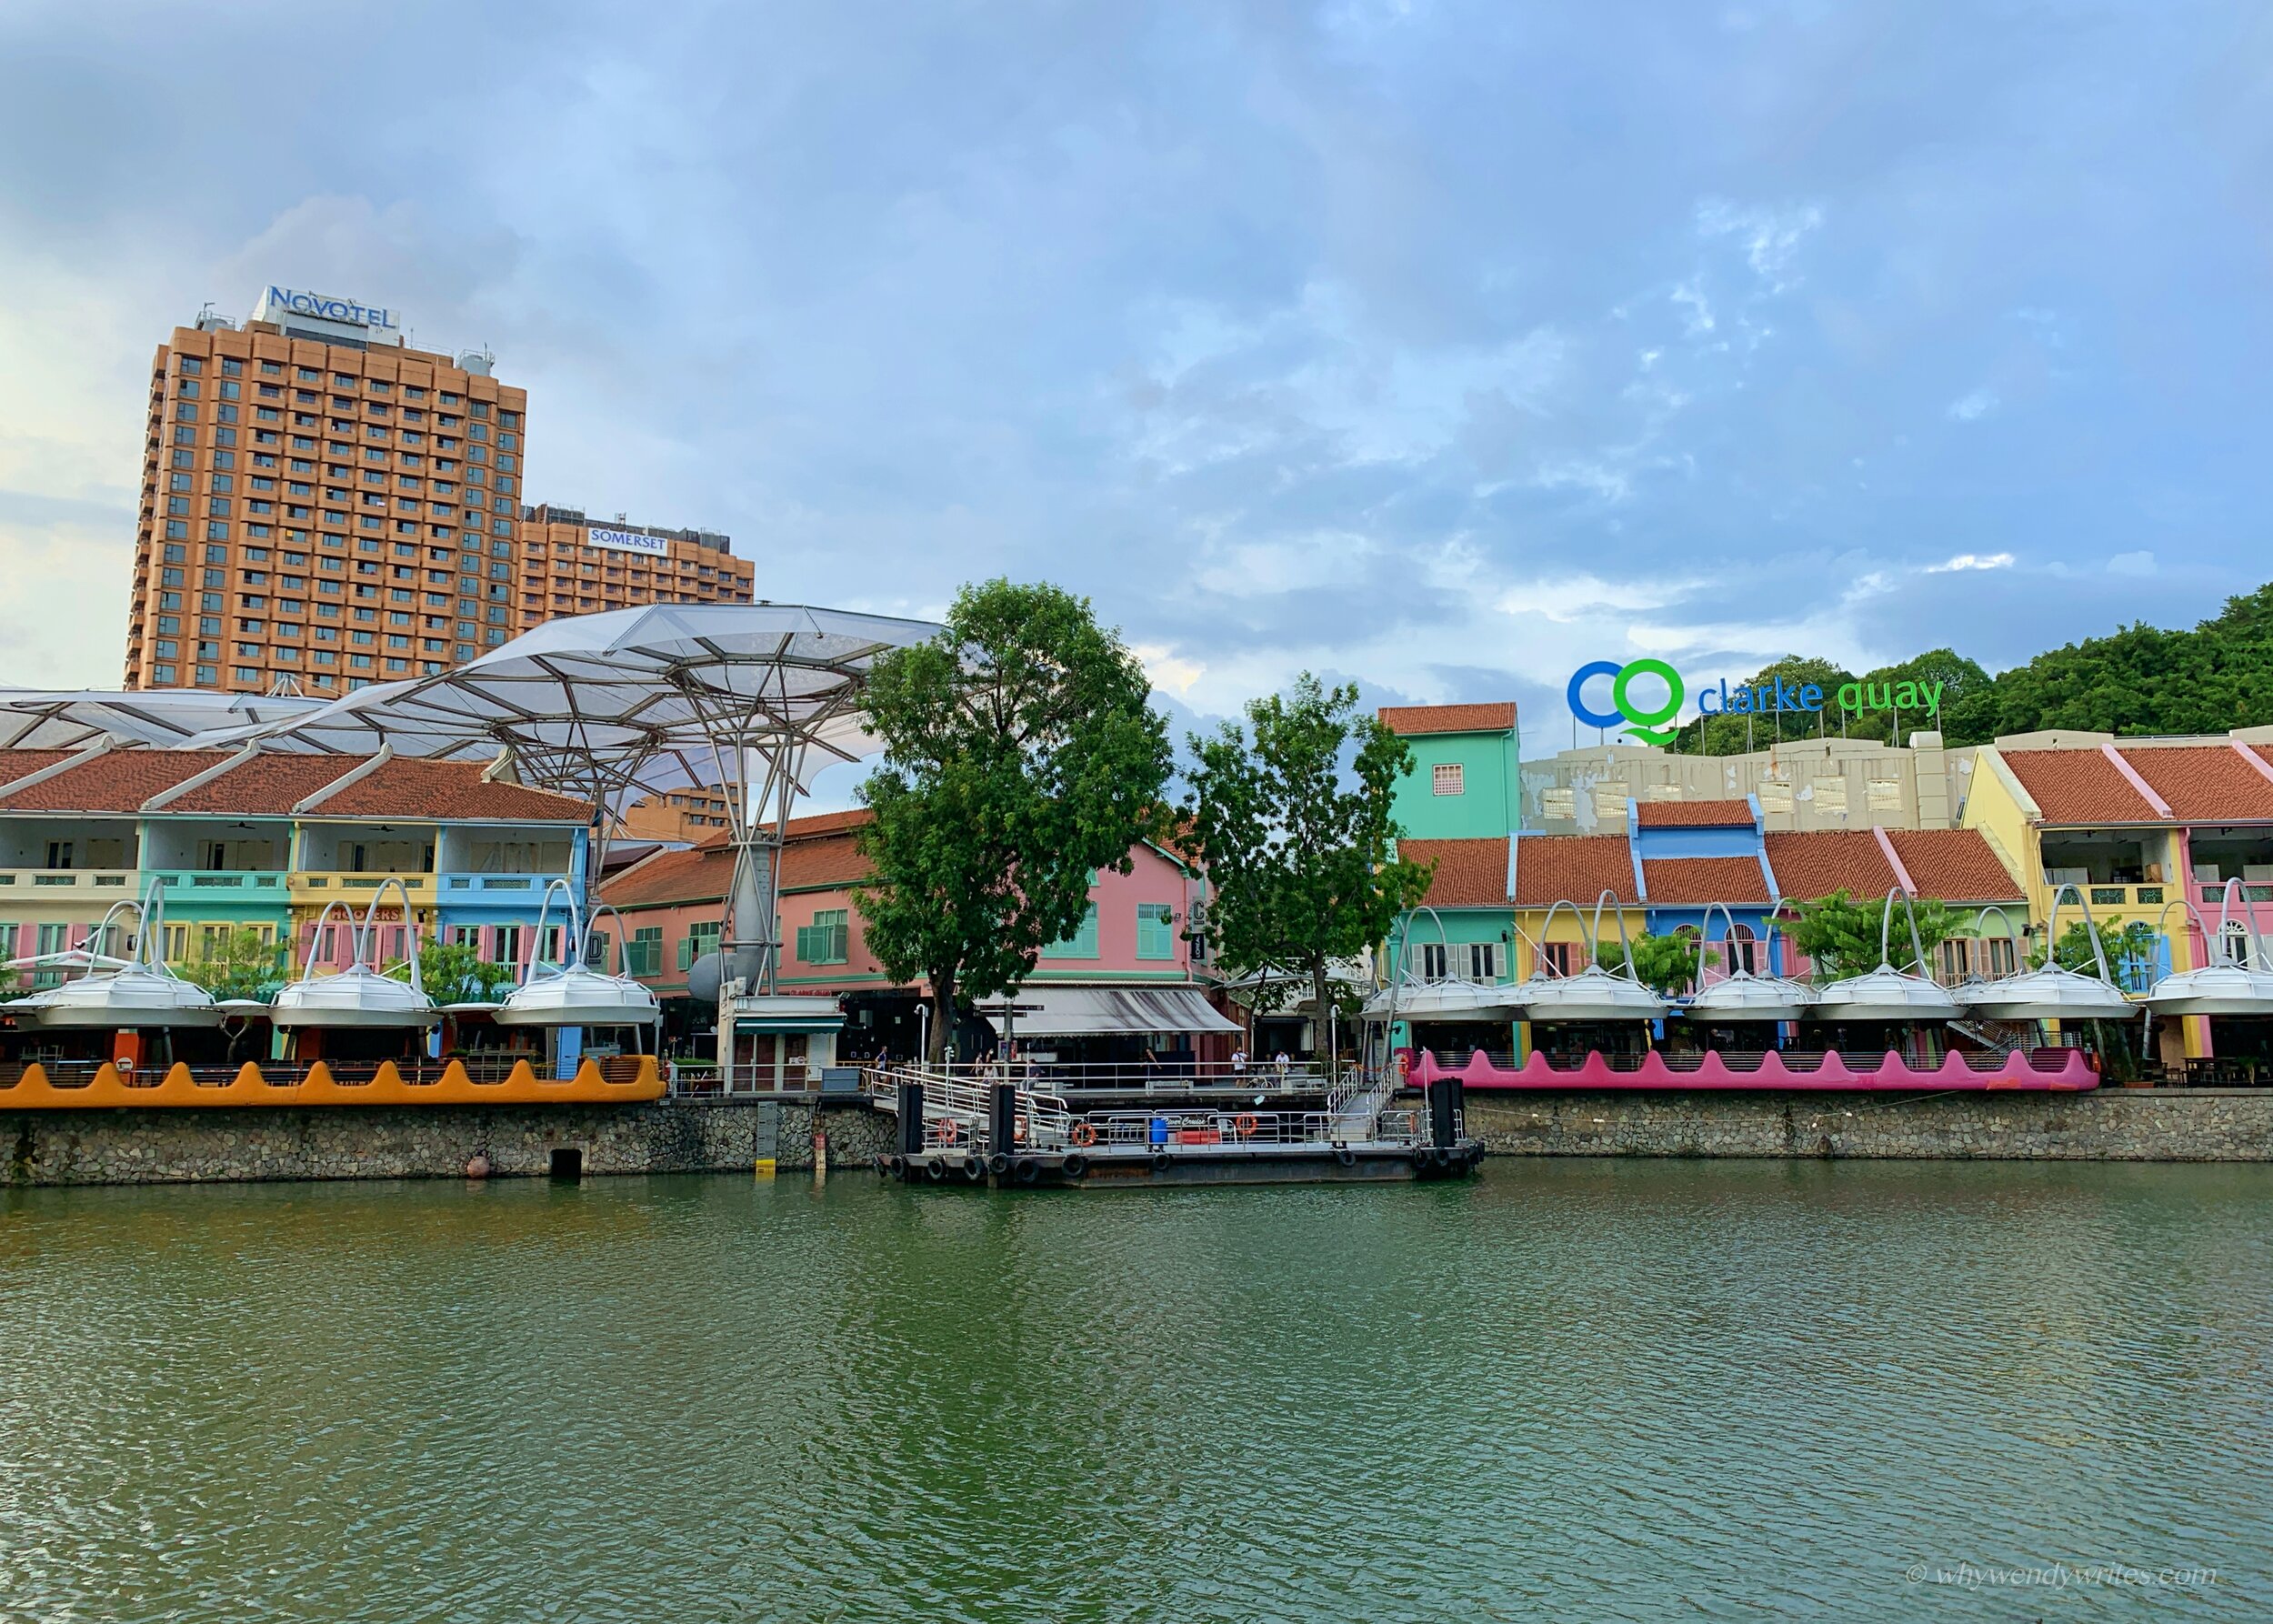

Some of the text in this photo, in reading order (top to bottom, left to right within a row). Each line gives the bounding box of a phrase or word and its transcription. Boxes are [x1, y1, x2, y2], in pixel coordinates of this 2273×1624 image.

[270, 286, 396, 328] NOVOTEL
[591, 529, 666, 549] SOMERSET
[1699, 676, 1944, 718] clarke quay
